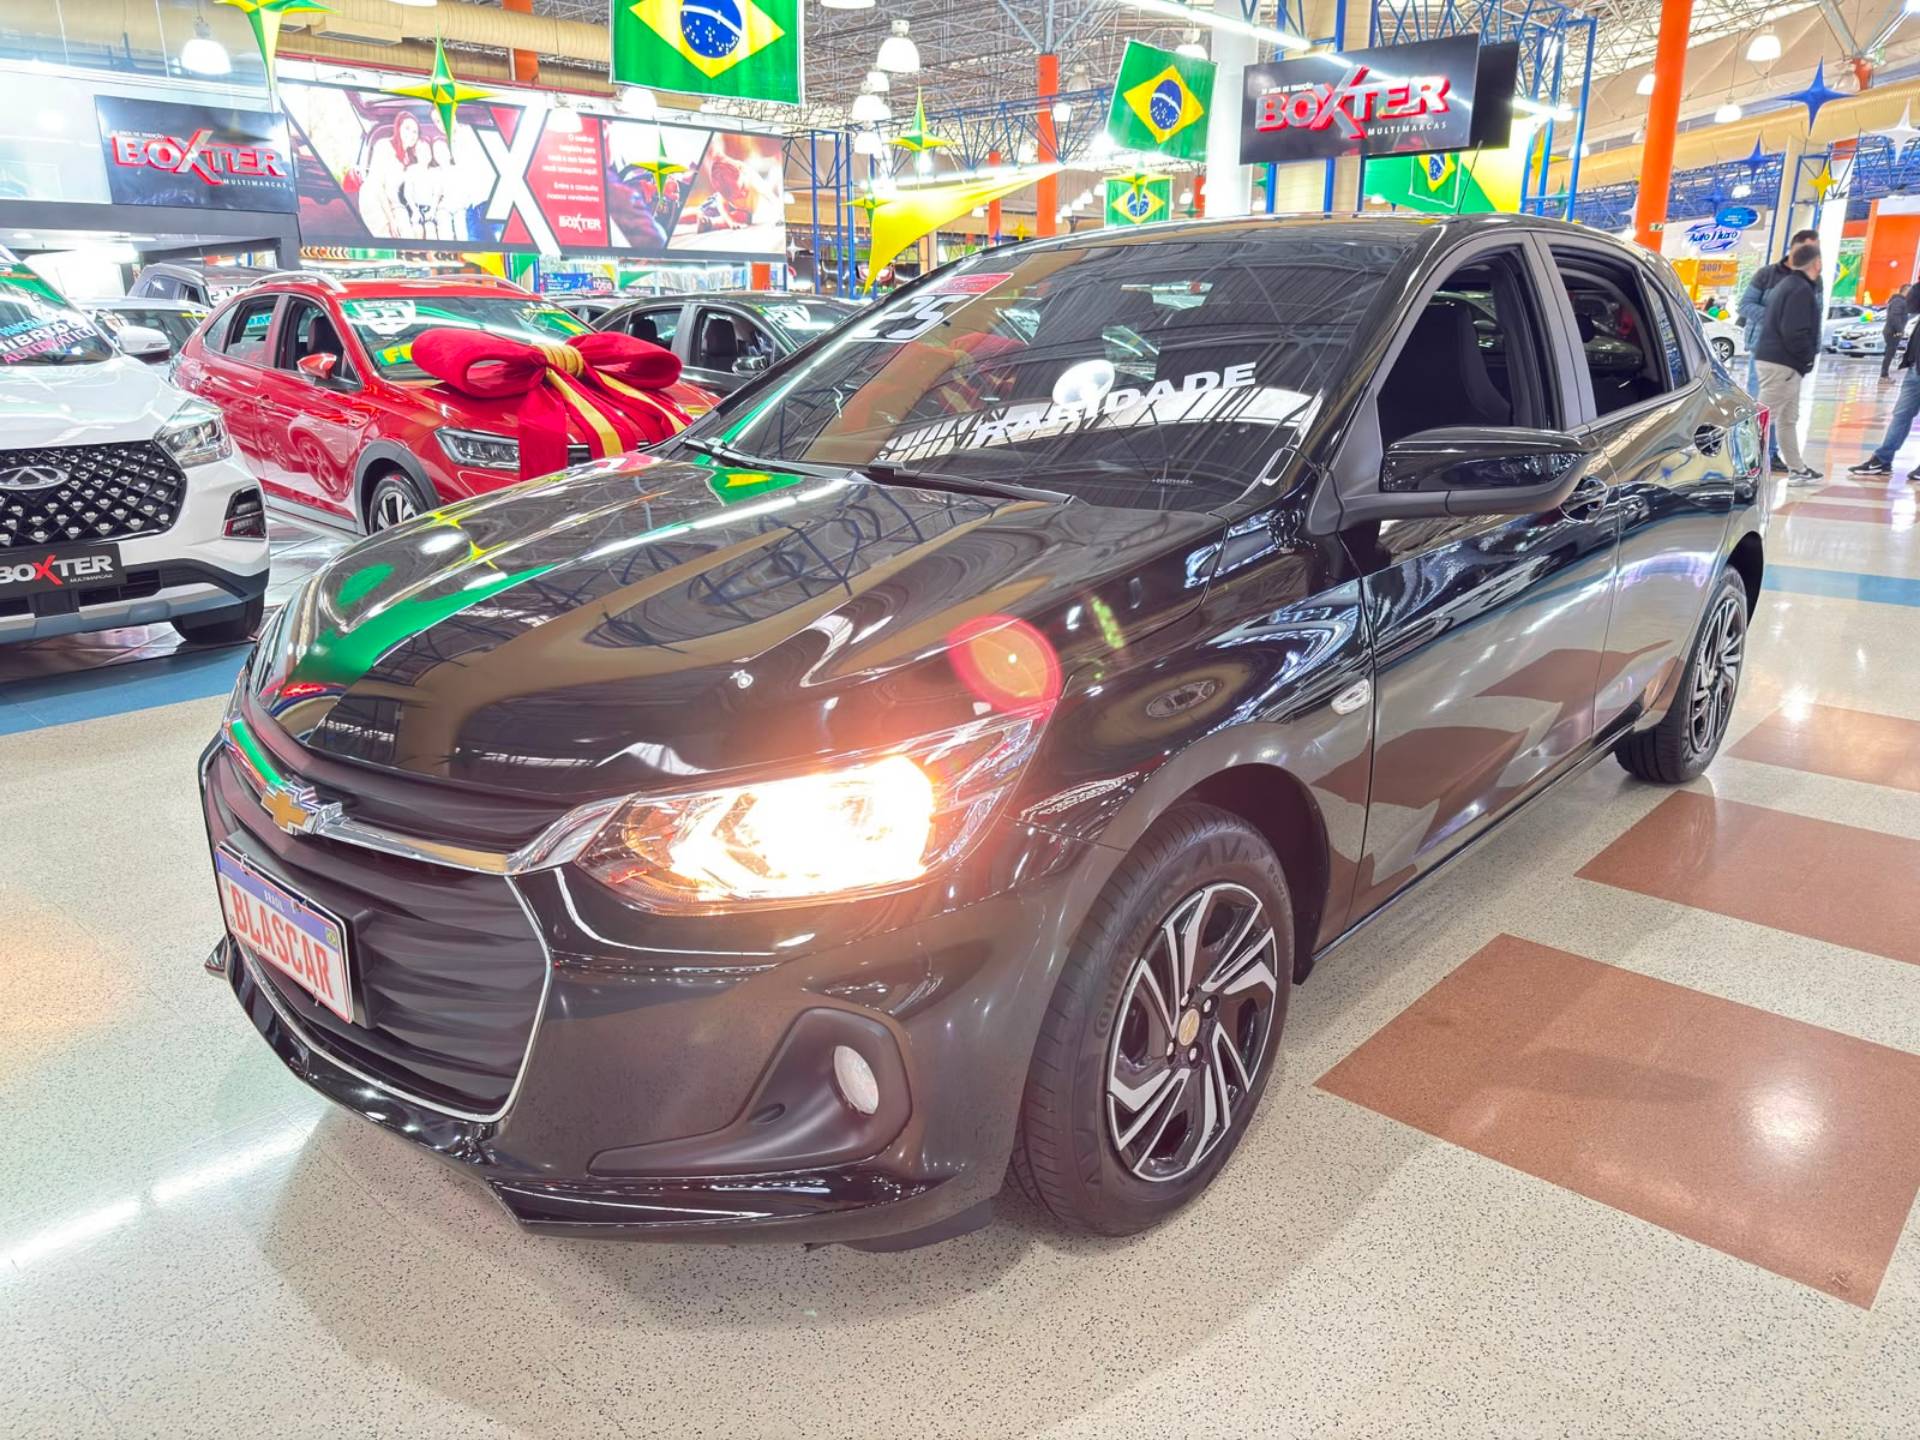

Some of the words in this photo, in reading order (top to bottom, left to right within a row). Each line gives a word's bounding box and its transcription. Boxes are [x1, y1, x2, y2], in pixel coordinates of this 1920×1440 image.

[1255, 64, 1450, 140] BOXTER
[1367, 121, 1448, 137] MULTIMARCAS
[111, 127, 289, 187] BOXTER
[223, 178, 287, 189] MULTIMARCAS
[559, 214, 602, 233] BOXTER
[973, 362, 1256, 446] RARIDADE
[0, 554, 114, 586] BOXTER
[230, 884, 334, 1000] BLASCAR
